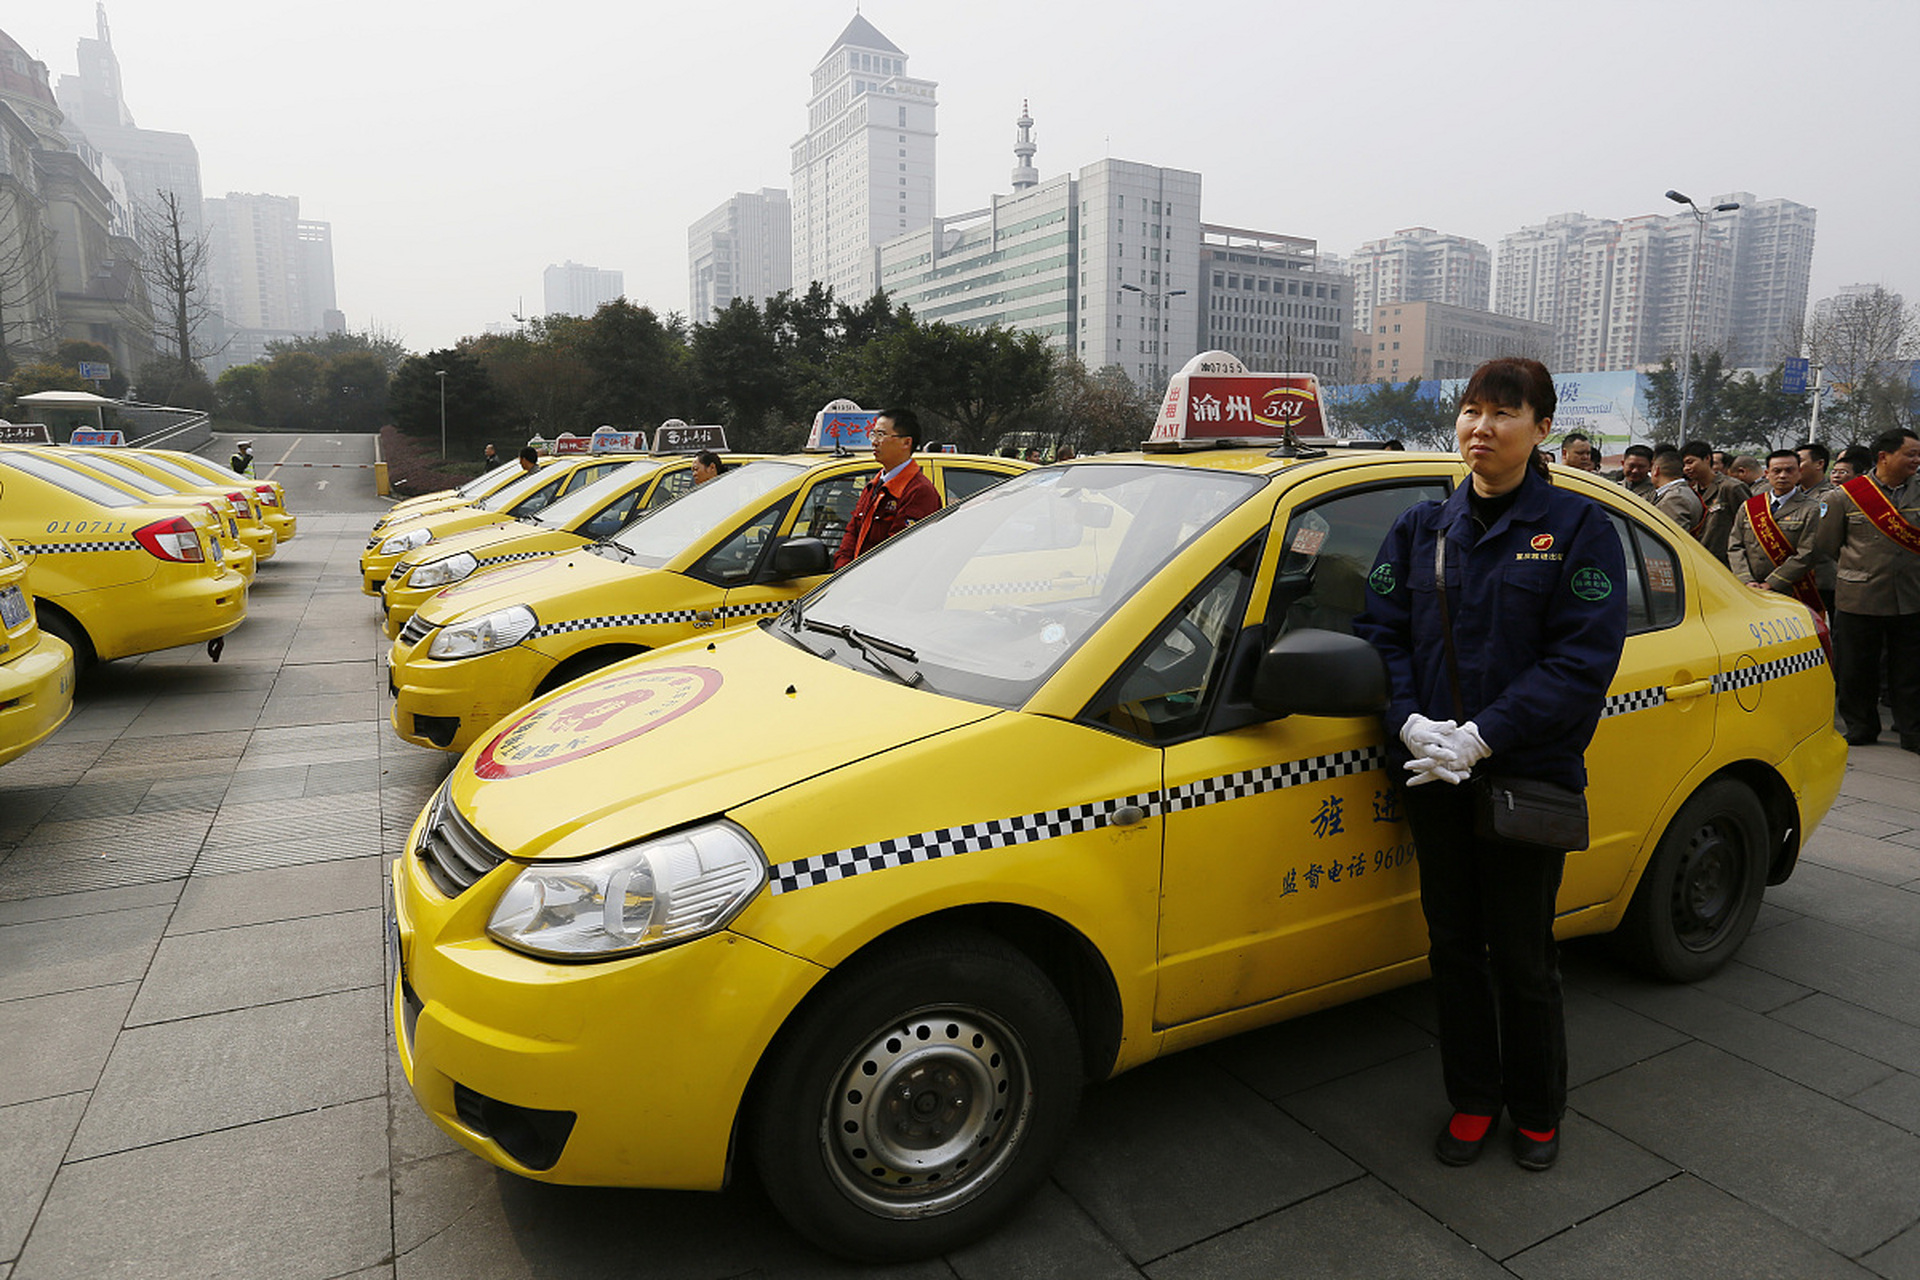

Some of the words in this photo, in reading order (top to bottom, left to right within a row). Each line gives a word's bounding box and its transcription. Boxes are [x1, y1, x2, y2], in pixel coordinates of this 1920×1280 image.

[1191, 394, 1253, 422] 渝州
[1264, 400, 1304, 418] 581
[1155, 423, 1180, 439] TAXI
[46, 521, 127, 534] 010711
[1748, 616, 1809, 648] 951207
[1279, 852, 1367, 899] 监督电话
[1373, 842, 1416, 873] 9609
